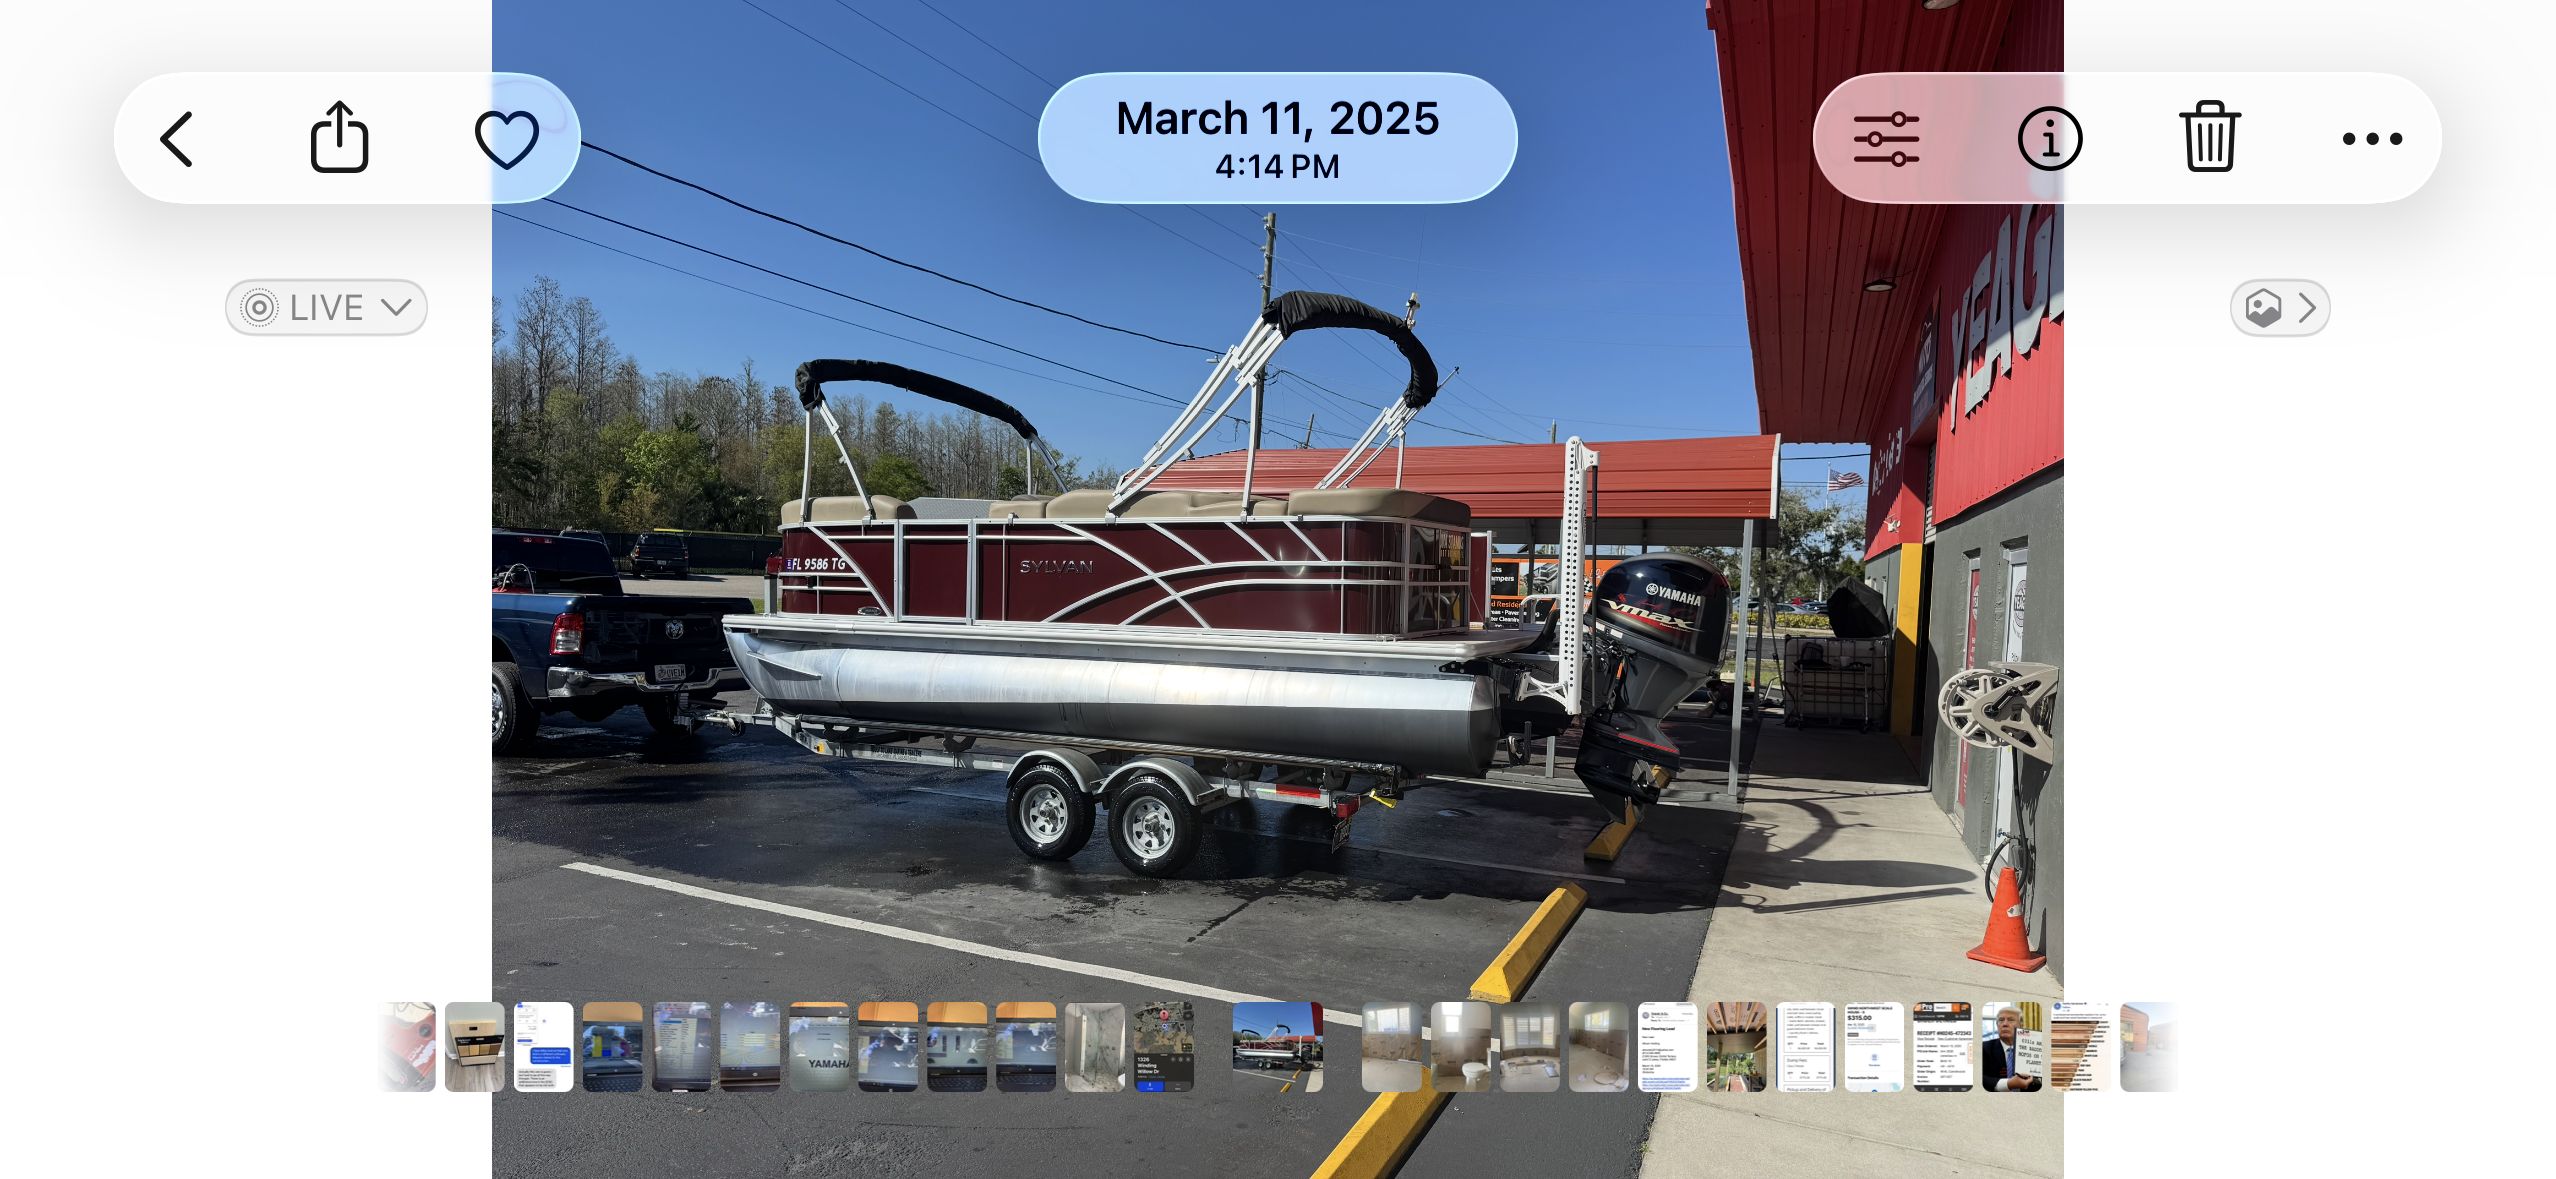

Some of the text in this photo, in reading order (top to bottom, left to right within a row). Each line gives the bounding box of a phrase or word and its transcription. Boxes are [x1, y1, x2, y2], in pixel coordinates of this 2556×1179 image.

[792, 557, 802, 570] FL
[804, 558, 829, 570] 9586
[832, 557, 846, 570] TG
[1020, 560, 1094, 574] SYLVAN
[1659, 585, 1702, 608] YAMAHA
